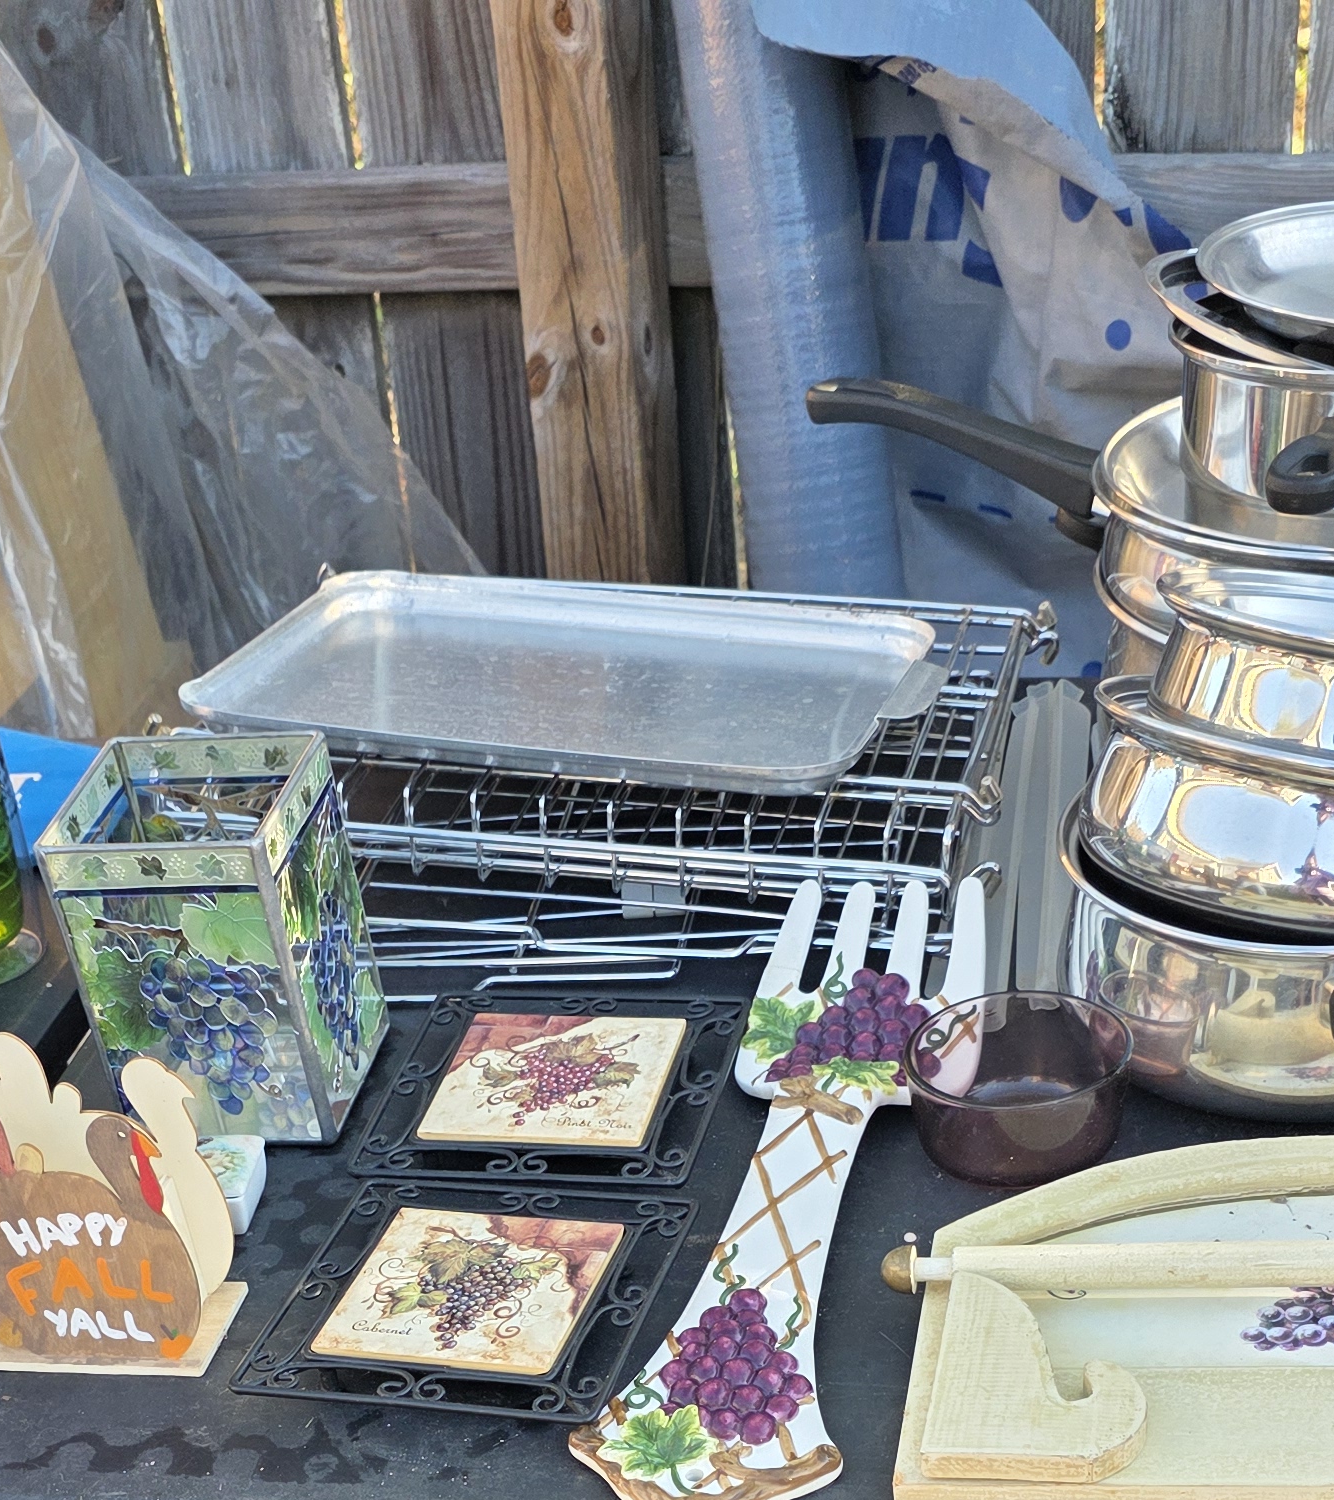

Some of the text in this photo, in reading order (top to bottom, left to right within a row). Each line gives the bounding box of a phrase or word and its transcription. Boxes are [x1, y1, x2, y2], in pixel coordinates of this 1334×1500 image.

[598, 1118, 633, 1129] Noir
[0, 1211, 129, 1258] HAPPY
[6, 1257, 175, 1317] FALL
[44, 1307, 155, 1343] YALL
[352, 1319, 414, 1336] Cabernet
